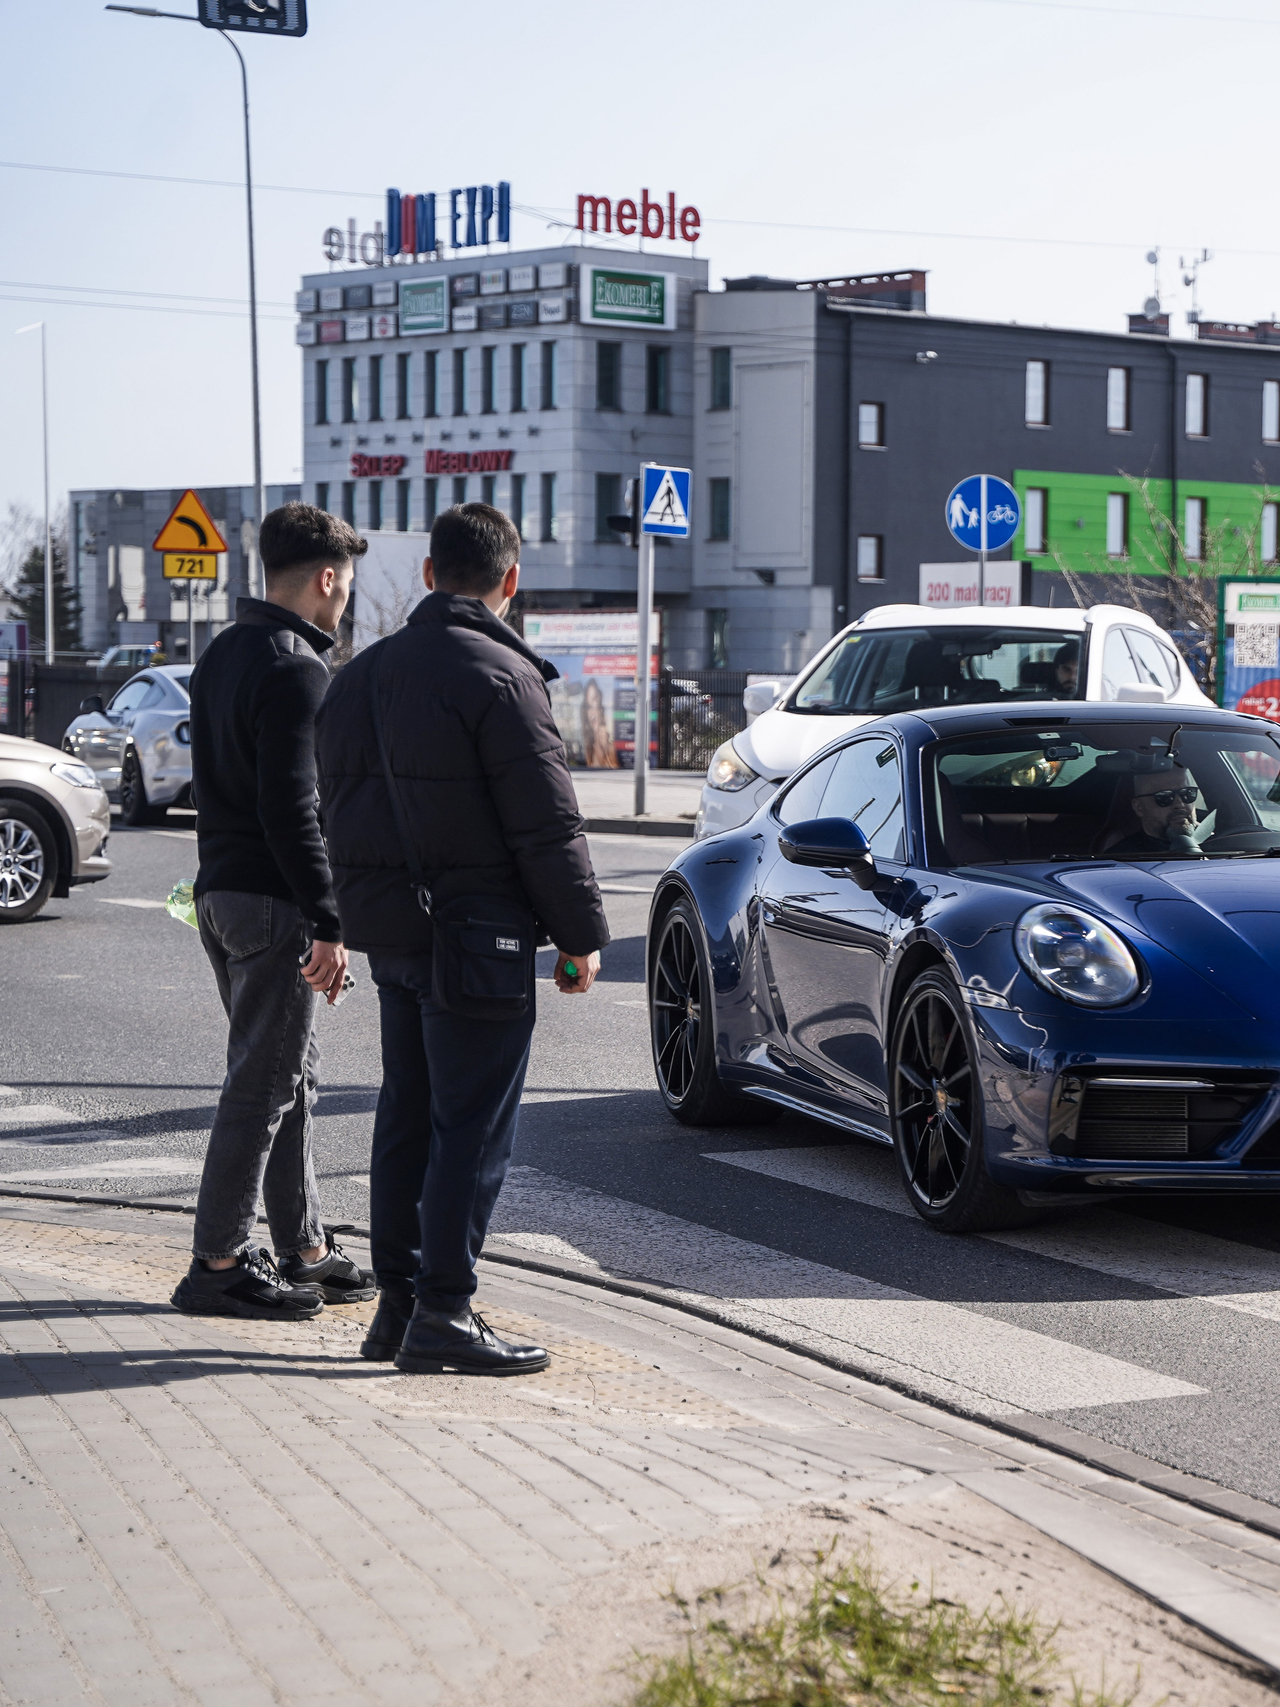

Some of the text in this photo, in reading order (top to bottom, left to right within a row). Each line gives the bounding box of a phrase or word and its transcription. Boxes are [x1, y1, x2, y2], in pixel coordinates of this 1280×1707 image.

[450, 181, 510, 249] EXPO
[576, 188, 700, 242] meble
[594, 276, 661, 308] EKOMEBLE
[351, 449, 513, 477] SKLEP MEBLOWY
[175, 558, 204, 574] 721
[927, 583, 1012, 605] 200 matracy
